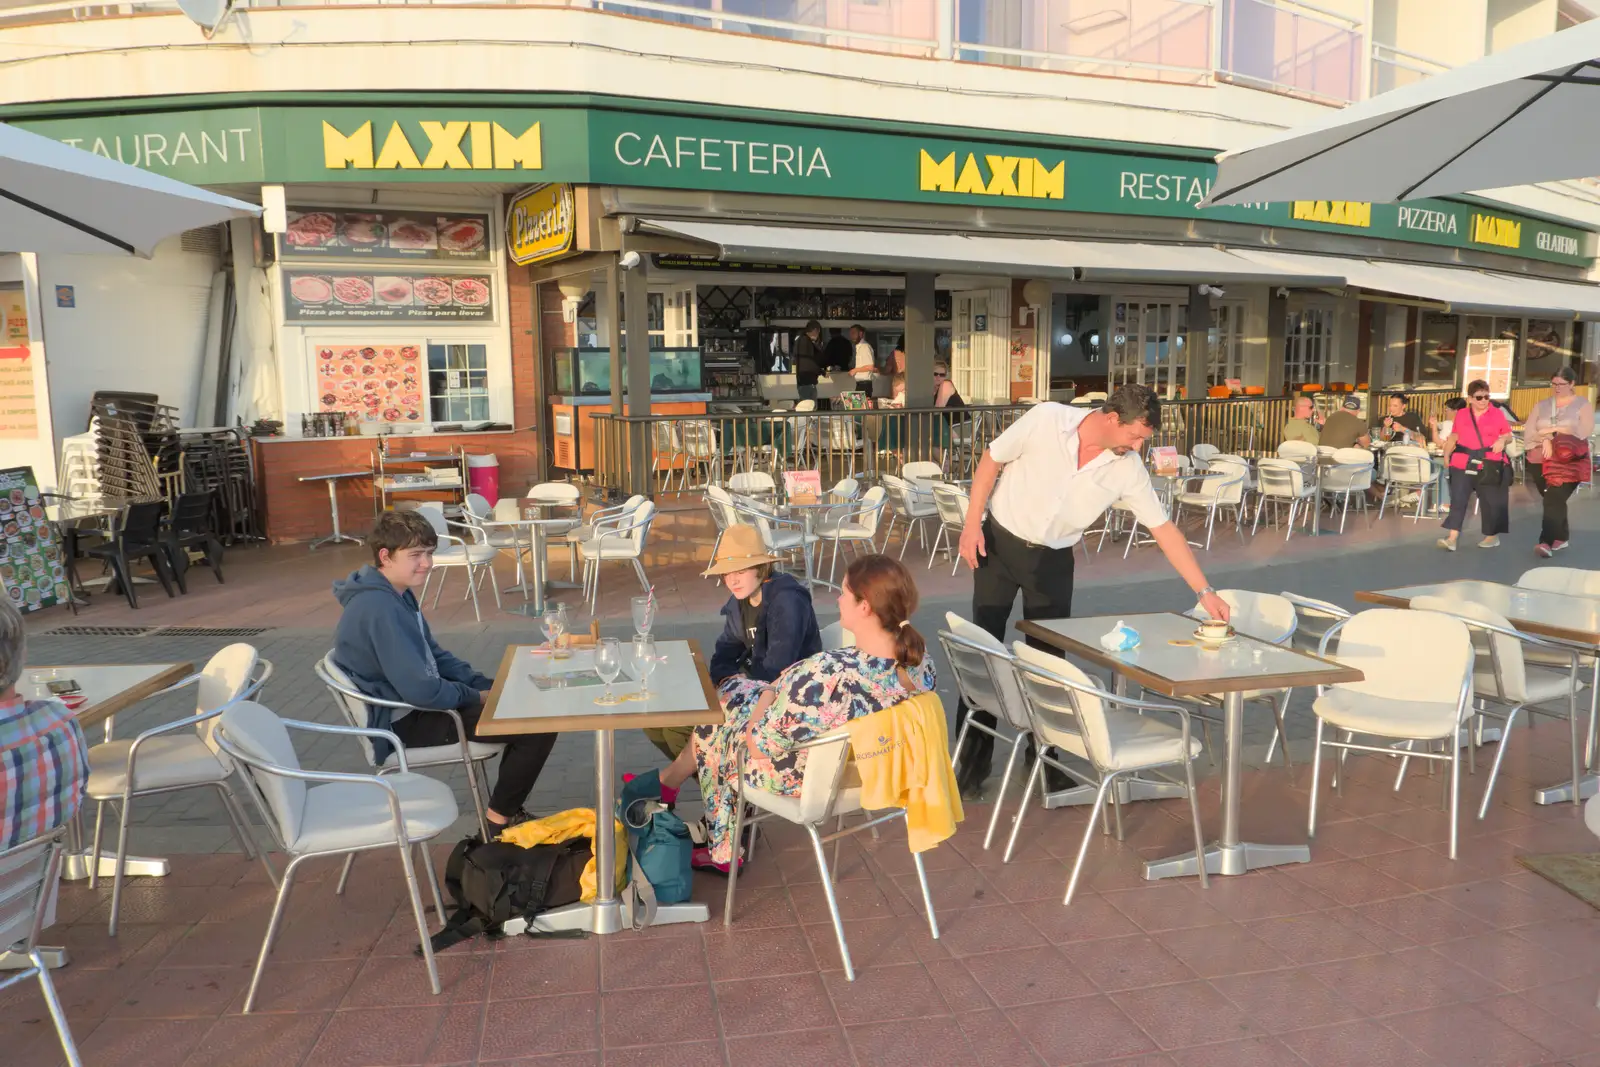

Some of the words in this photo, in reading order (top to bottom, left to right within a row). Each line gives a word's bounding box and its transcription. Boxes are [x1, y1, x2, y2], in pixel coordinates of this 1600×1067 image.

[322, 119, 543, 170] MAXIM
[614, 131, 832, 178] CAFETERIA
[919, 148, 1067, 200] MAXIM
[1397, 206, 1457, 235] PIZZERIA
[1471, 213, 1521, 248] MAXIM
[1536, 231, 1579, 257] GELATERIA
[299, 308, 326, 316] Pizza
[408, 309, 434, 317] Pizza
[435, 310, 457, 318] para
[458, 309, 485, 317] llevar
